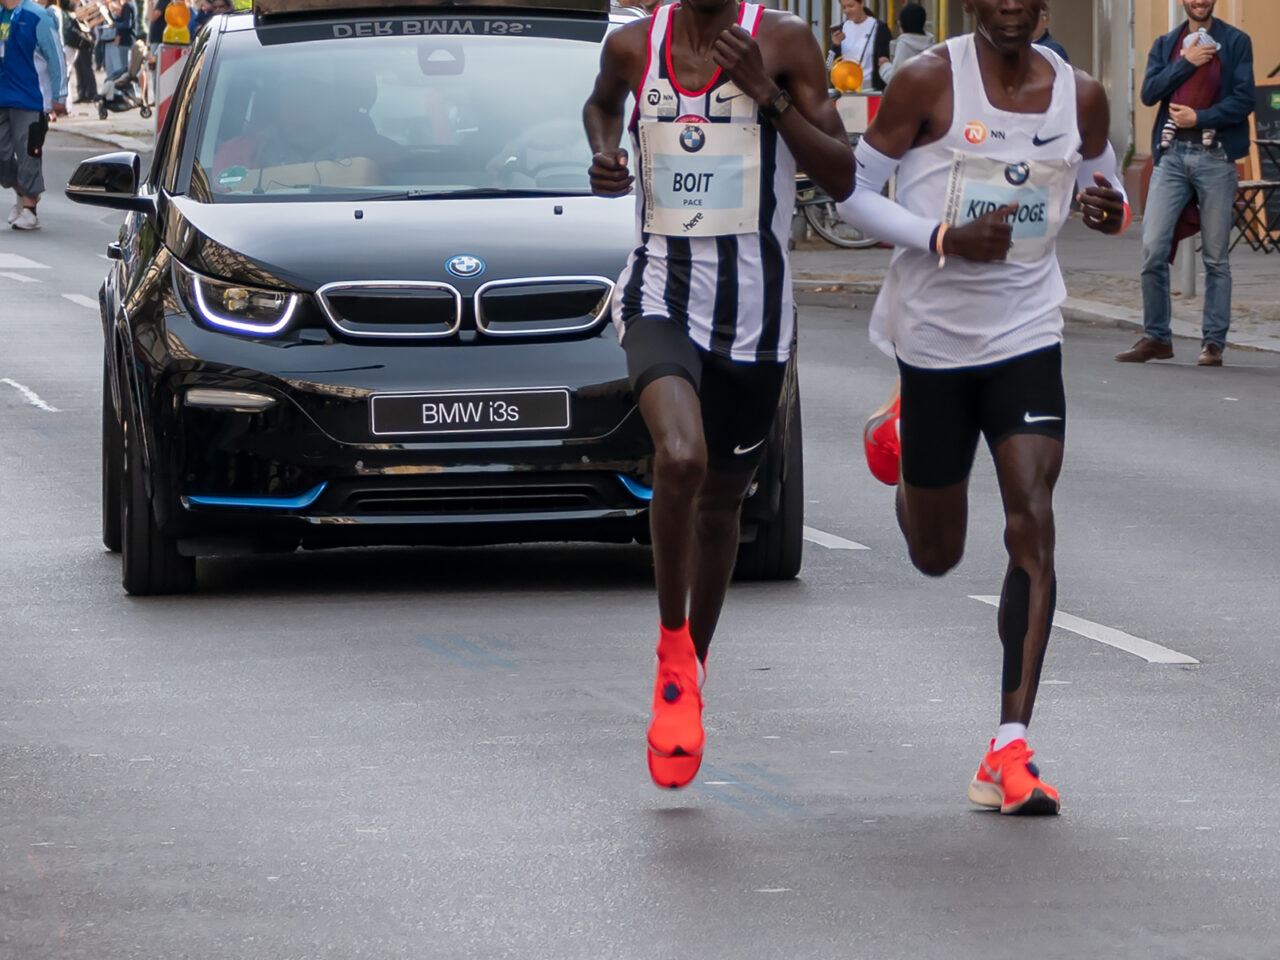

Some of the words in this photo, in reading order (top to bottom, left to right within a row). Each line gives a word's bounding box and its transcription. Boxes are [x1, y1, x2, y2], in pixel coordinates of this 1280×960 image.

[990, 130, 1006, 140] NN
[673, 173, 714, 192] BOIT
[422, 403, 483, 424] BMW
[488, 401, 519, 422] i3s
